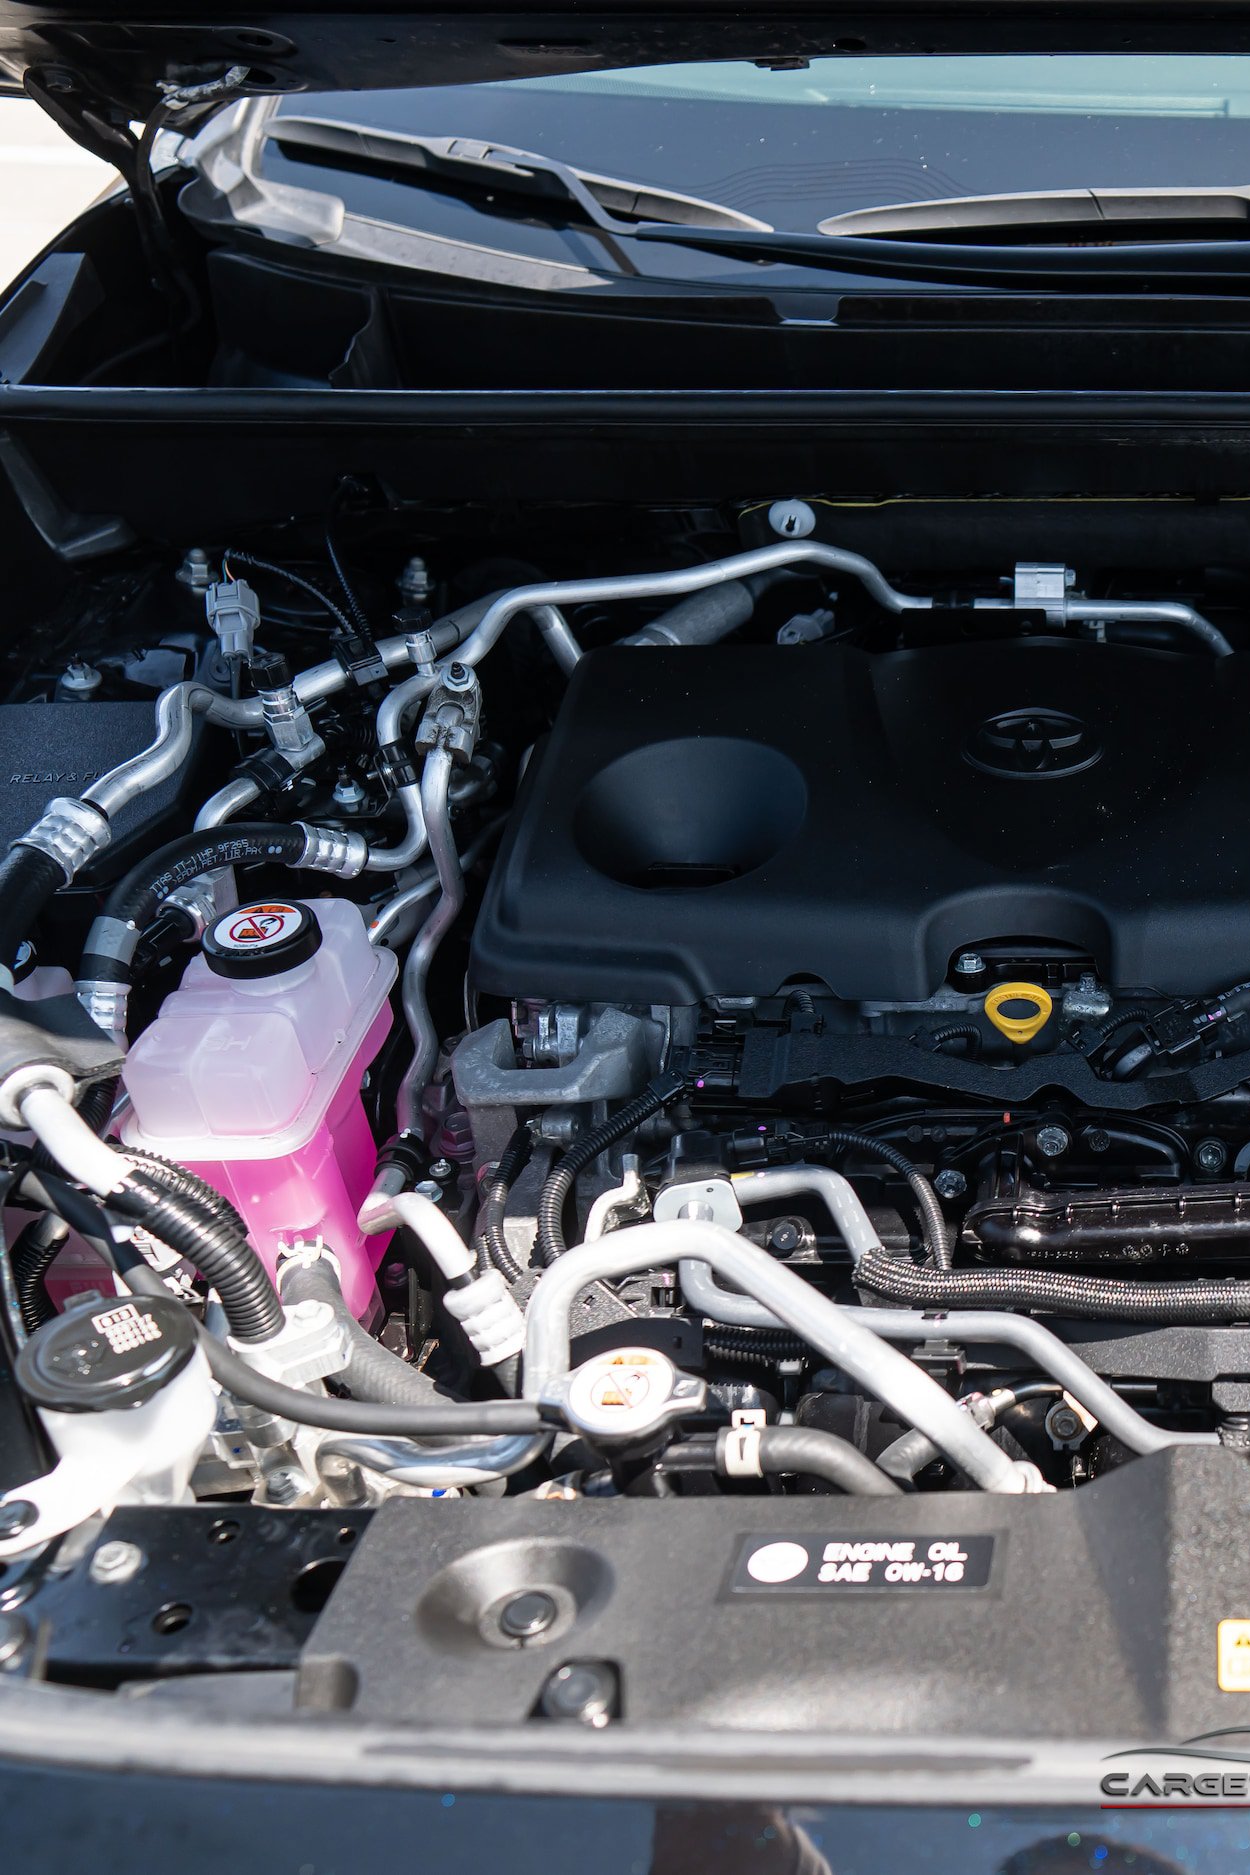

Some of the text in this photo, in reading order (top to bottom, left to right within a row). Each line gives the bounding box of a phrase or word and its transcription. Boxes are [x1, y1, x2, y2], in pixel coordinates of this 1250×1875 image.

[822, 1542, 968, 1562] ENGINE OIL
[817, 1562, 872, 1583] SAE
